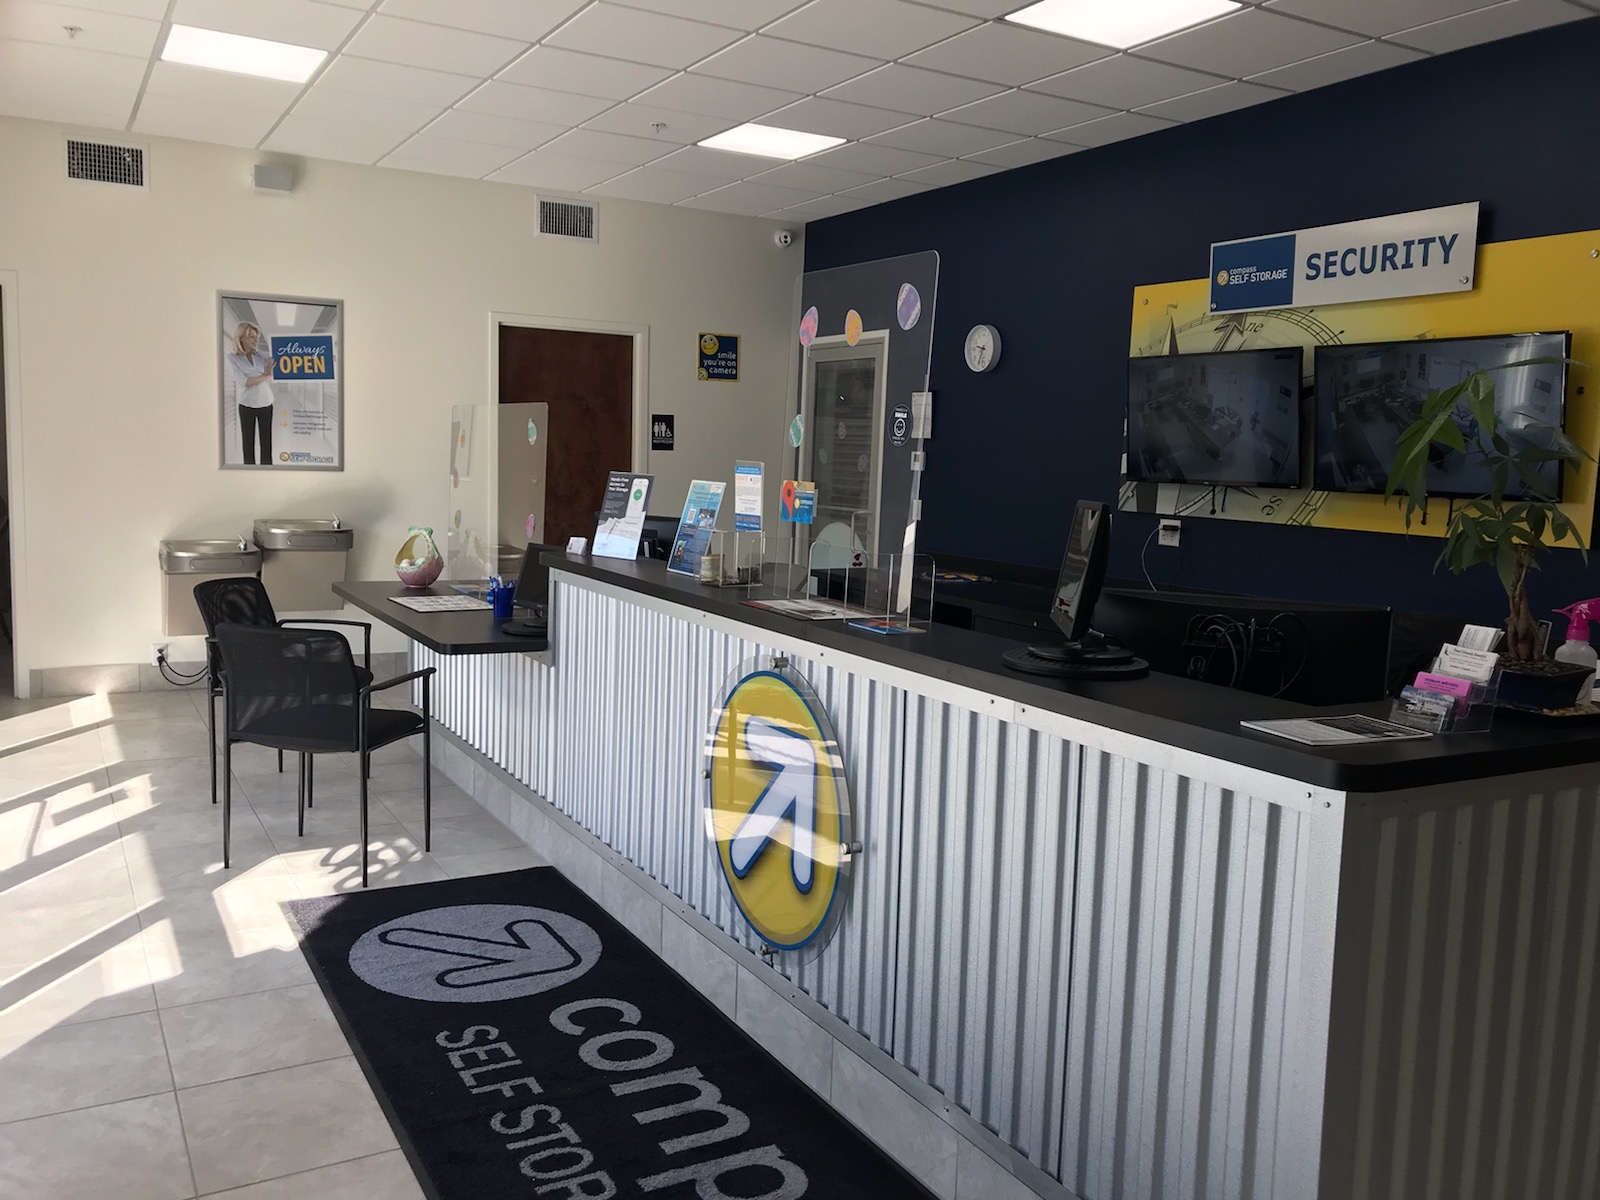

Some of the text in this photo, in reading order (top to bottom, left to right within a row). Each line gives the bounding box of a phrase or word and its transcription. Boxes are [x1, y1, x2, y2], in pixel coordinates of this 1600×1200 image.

[1305, 233, 1459, 281] SECURITY
[1229, 265, 1257, 277] compass
[1229, 268, 1288, 285] SELF STORAGE
[277, 342, 326, 358] Always
[717, 351, 736, 359] smile
[279, 355, 326, 374] OPEN
[703, 359, 727, 367] you're
[708, 367, 736, 375] camera
[435, 1024, 544, 1098] SELF
